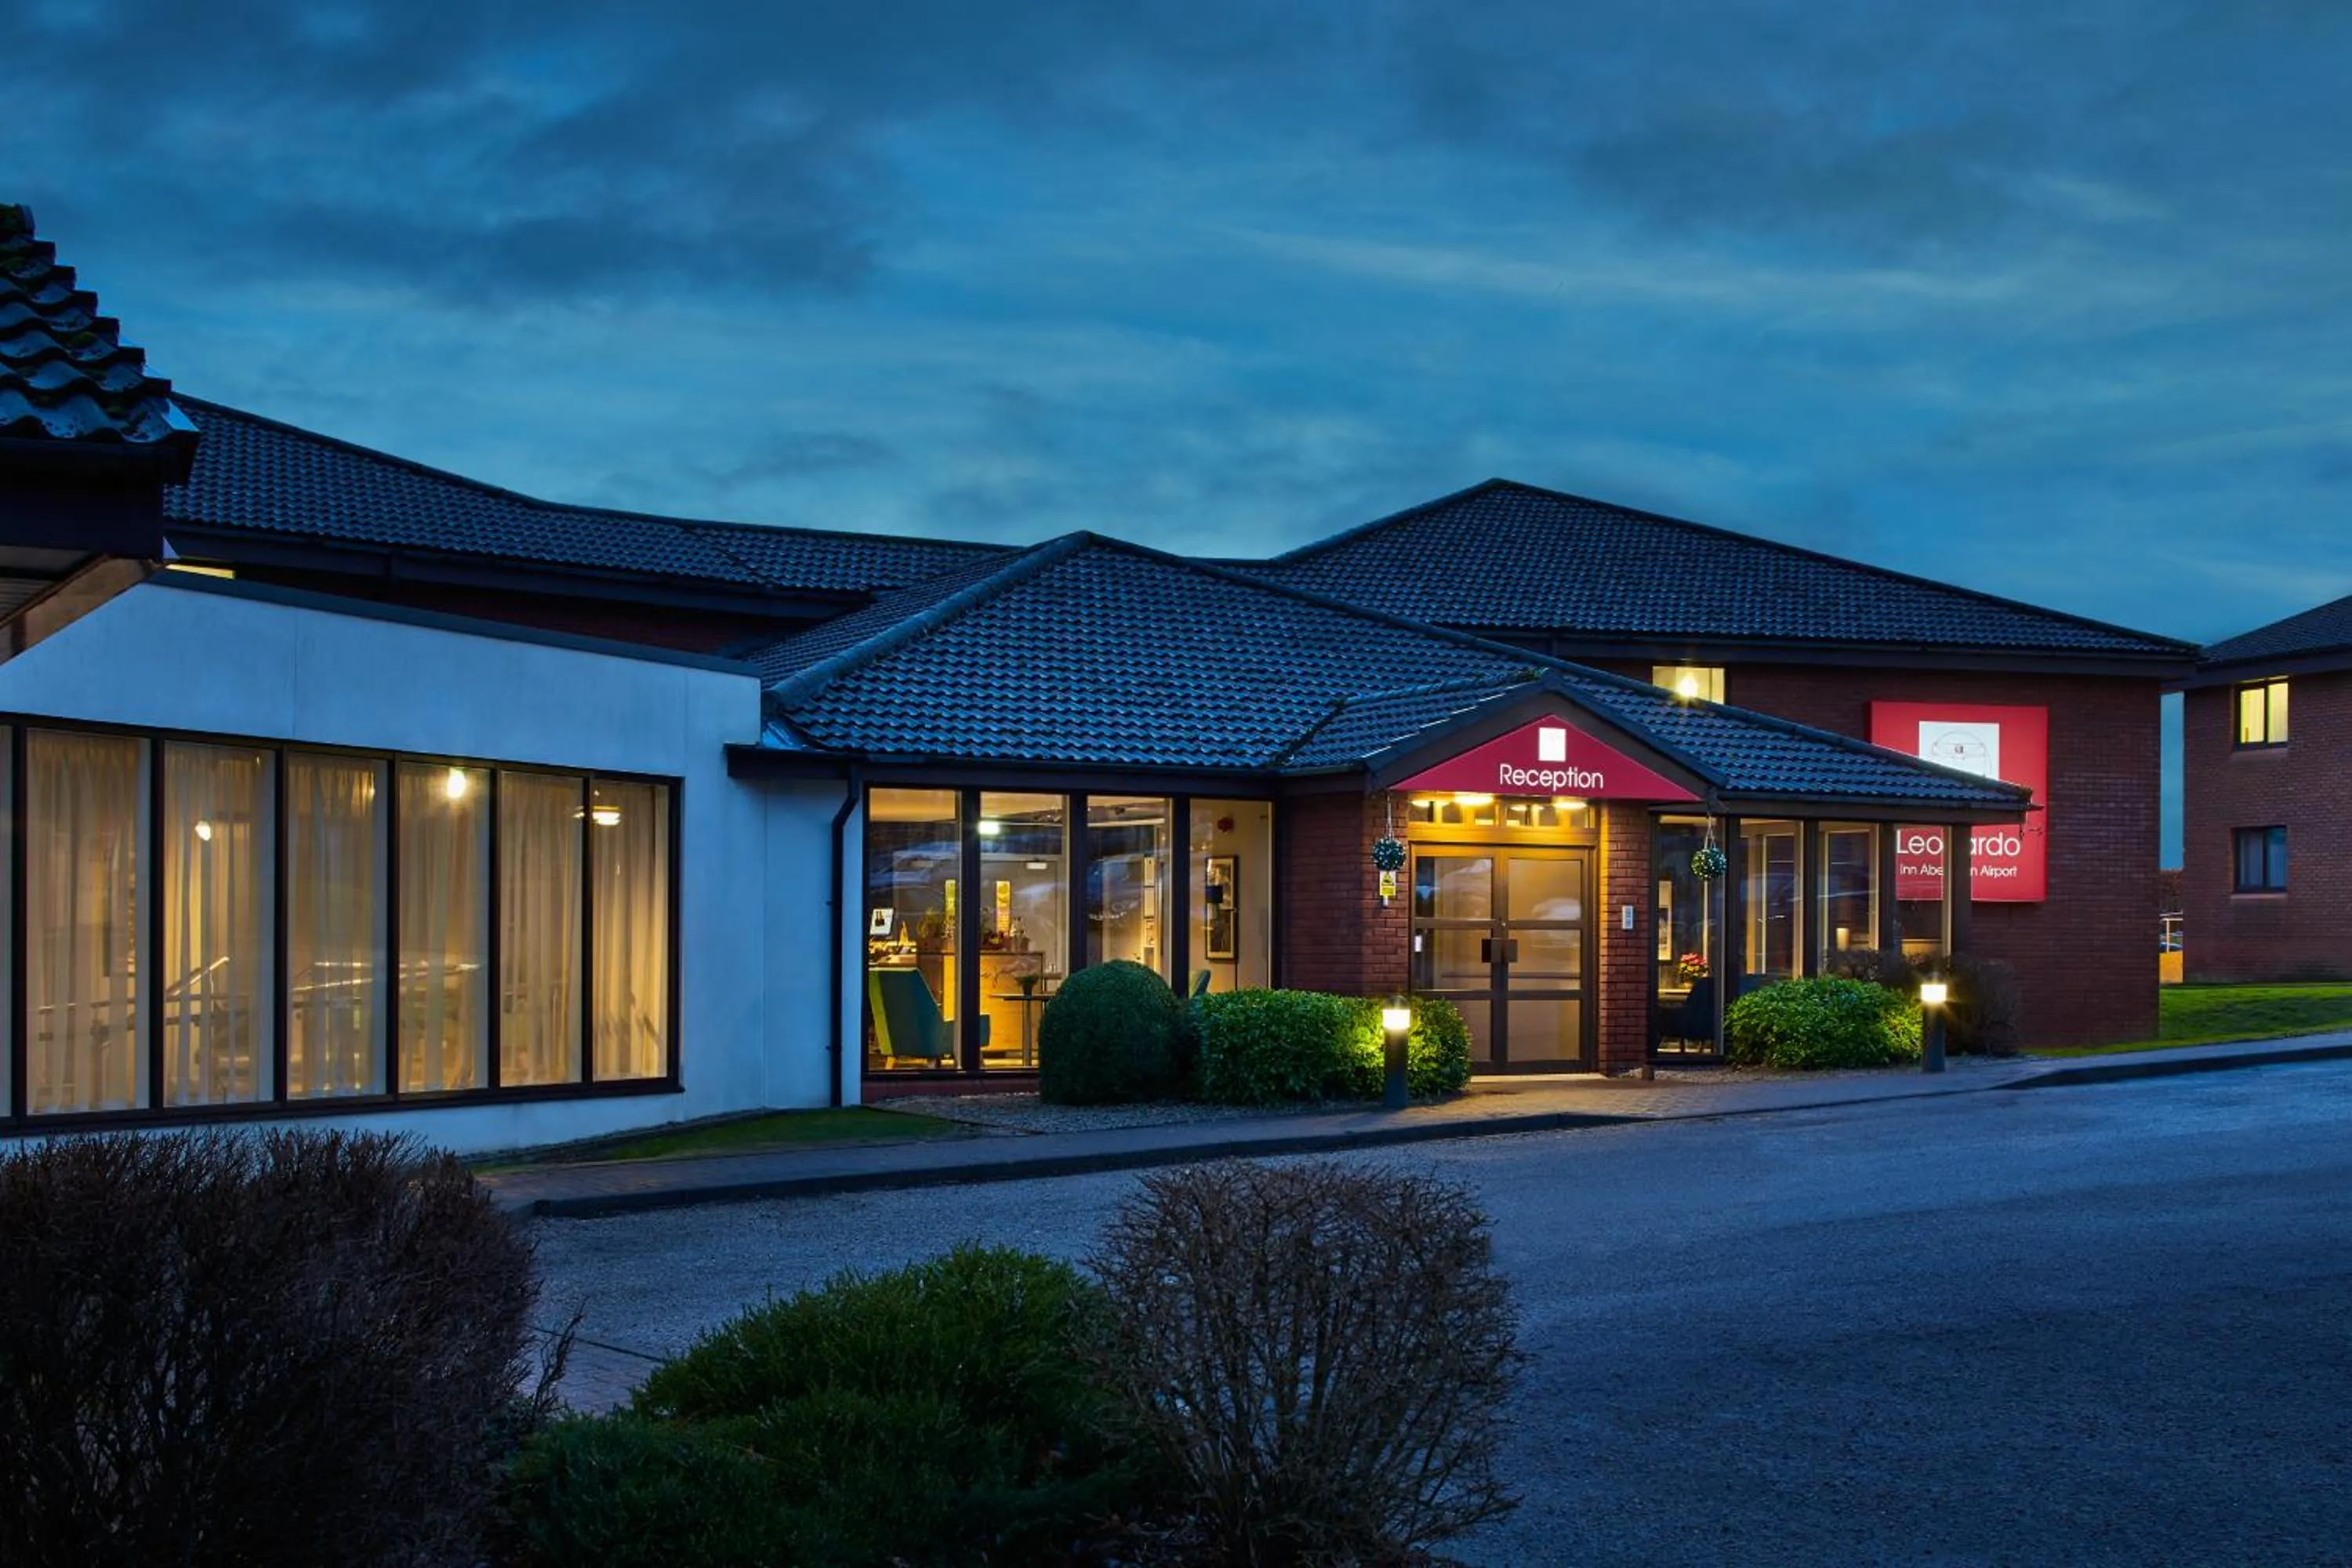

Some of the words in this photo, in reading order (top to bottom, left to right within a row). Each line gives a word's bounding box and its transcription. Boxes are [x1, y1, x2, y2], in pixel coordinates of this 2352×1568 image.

[1500, 763, 1604, 792] Reception
[1896, 829, 2020, 856] Leordo
[1900, 864, 1917, 876] Inn
[1920, 864, 1979, 877] Aben
[1980, 865, 2018, 879] Airport
